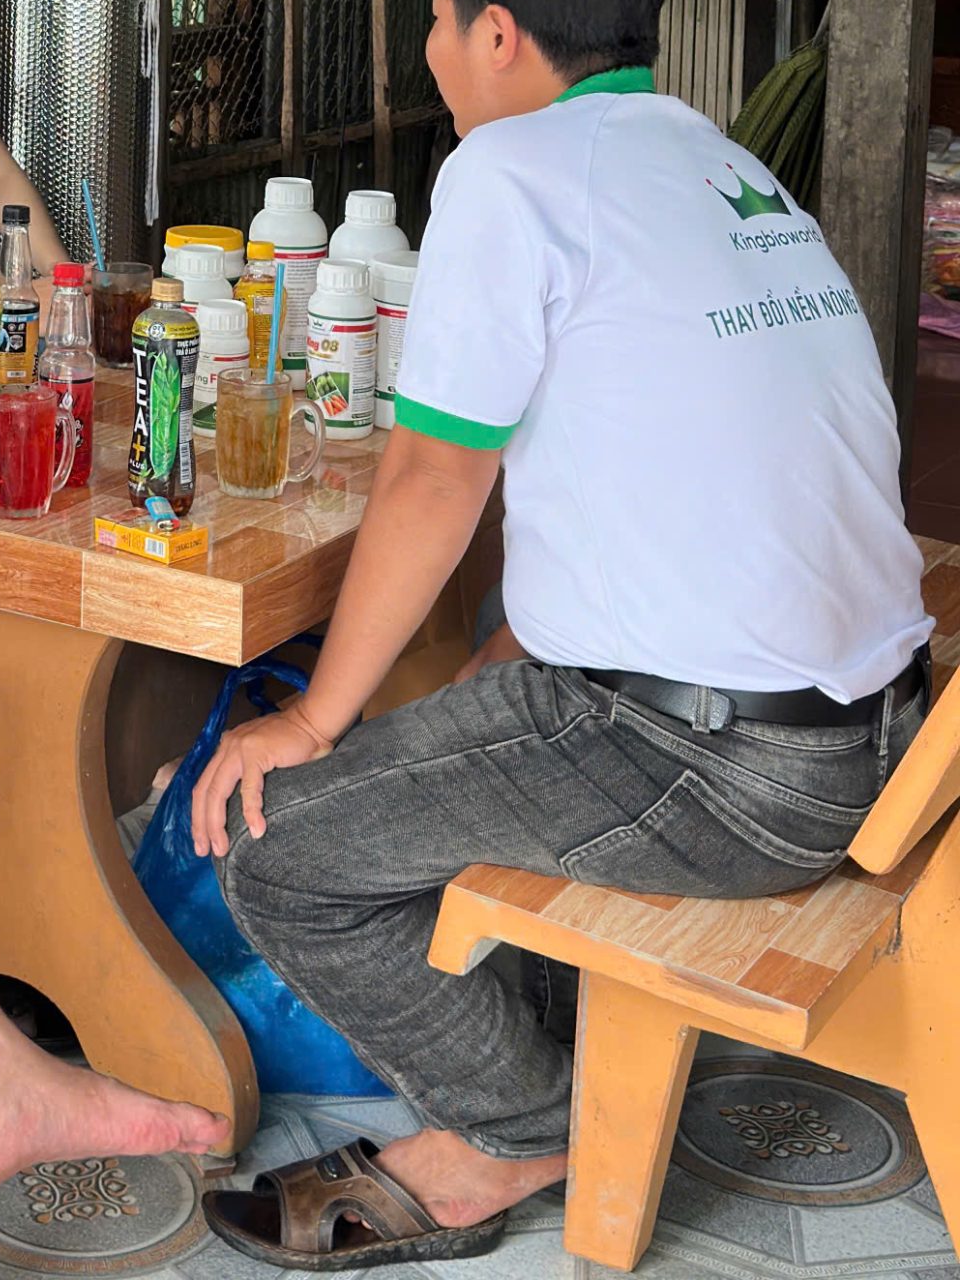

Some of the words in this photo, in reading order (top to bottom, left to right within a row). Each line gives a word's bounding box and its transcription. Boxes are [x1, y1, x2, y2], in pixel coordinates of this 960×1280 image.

[706, 303, 758, 338] THAY
[818, 284, 858, 318] NÔNG
[321, 338, 340, 352] 08
[132, 347, 148, 436] TEA
